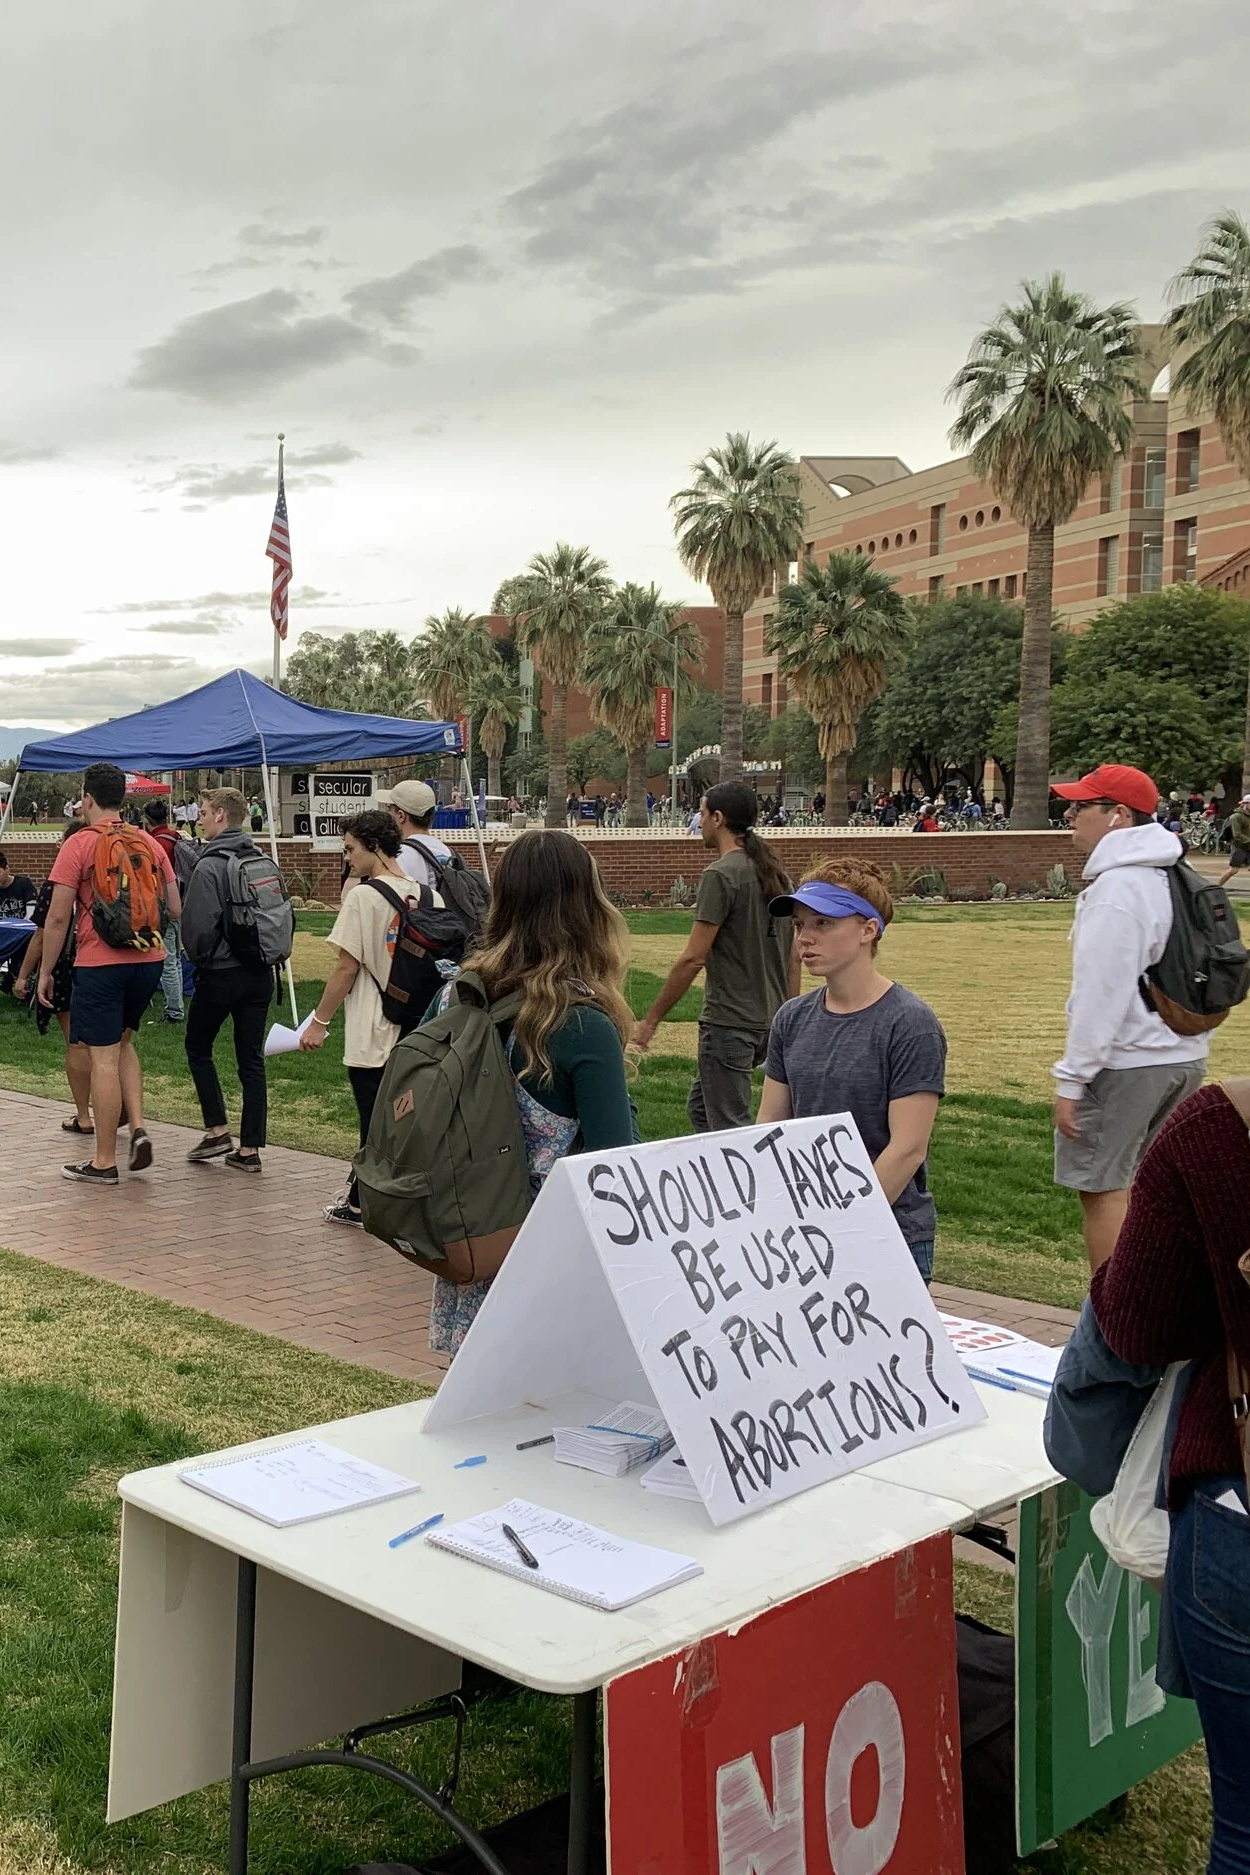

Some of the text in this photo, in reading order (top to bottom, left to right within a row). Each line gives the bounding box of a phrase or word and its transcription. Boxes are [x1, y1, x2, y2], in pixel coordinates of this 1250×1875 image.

[319, 778, 367, 794] secular
[319, 799, 366, 814] student
[587, 1124, 873, 1246] SHOULD TAXES
[671, 1225, 834, 1314] BE USED
[660, 1282, 891, 1399] TO PAY FOR
[710, 1317, 960, 1504] ABORTIONS?
[1065, 1552, 1168, 1748] YE
[716, 1680, 906, 1875] NO
